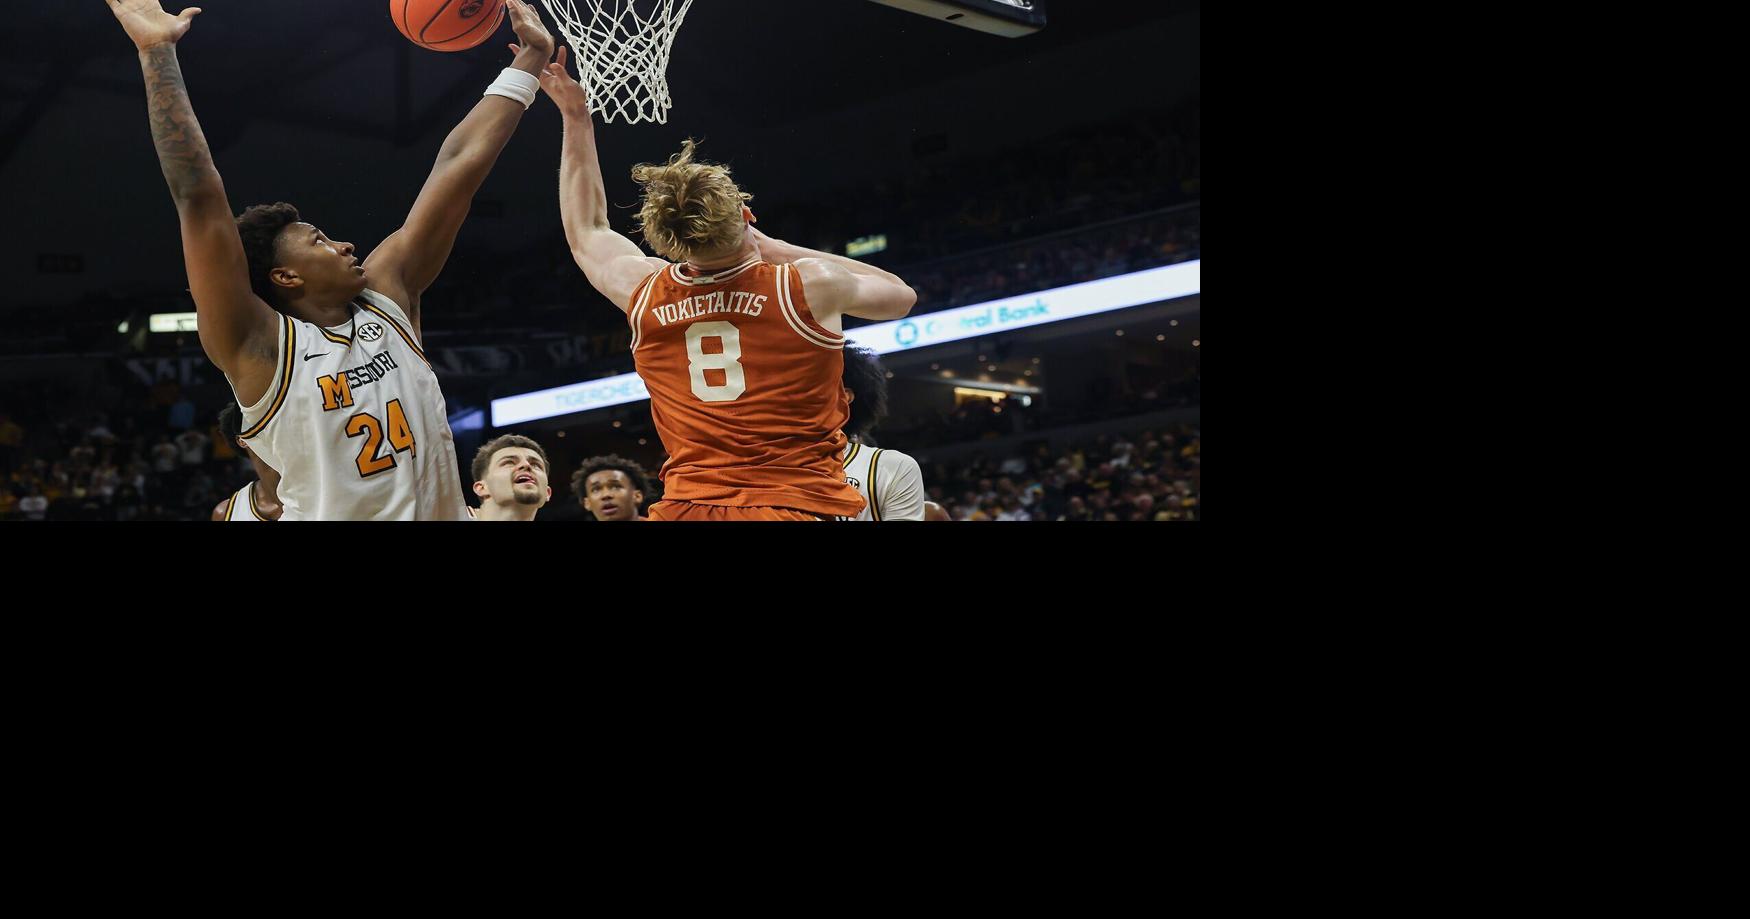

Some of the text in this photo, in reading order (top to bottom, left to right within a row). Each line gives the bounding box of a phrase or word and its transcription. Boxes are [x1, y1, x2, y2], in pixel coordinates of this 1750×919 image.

[652, 291, 768, 326] VOKIETAITIS
[998, 299, 1049, 323] Bank
[357, 322, 384, 341] SEC
[684, 321, 746, 402] 8
[344, 398, 416, 478] 24
